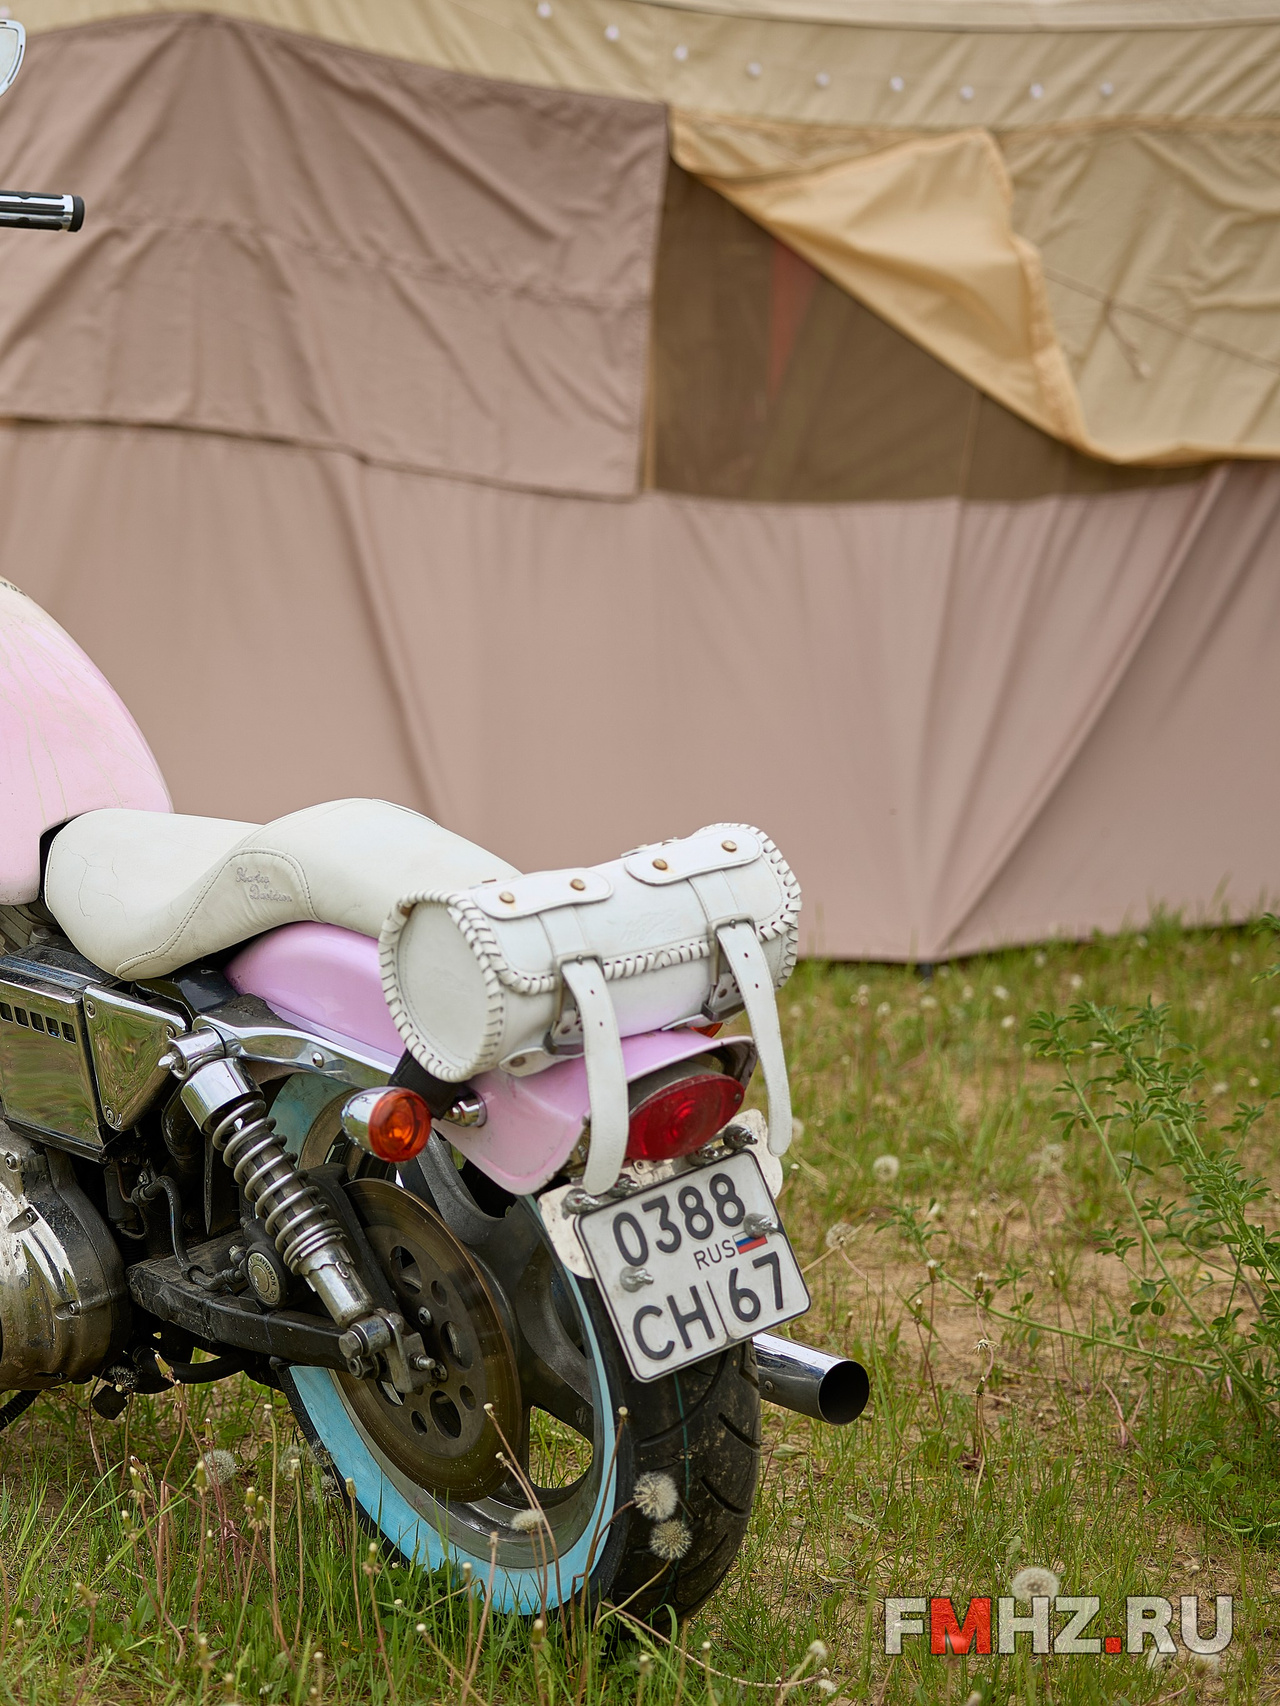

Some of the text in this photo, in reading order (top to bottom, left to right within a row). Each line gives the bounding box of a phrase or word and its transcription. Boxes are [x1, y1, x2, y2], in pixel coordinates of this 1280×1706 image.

[612, 1173, 746, 1266] 0388
[693, 1239, 736, 1270] RUS
[632, 1250, 784, 1361] CH 67
